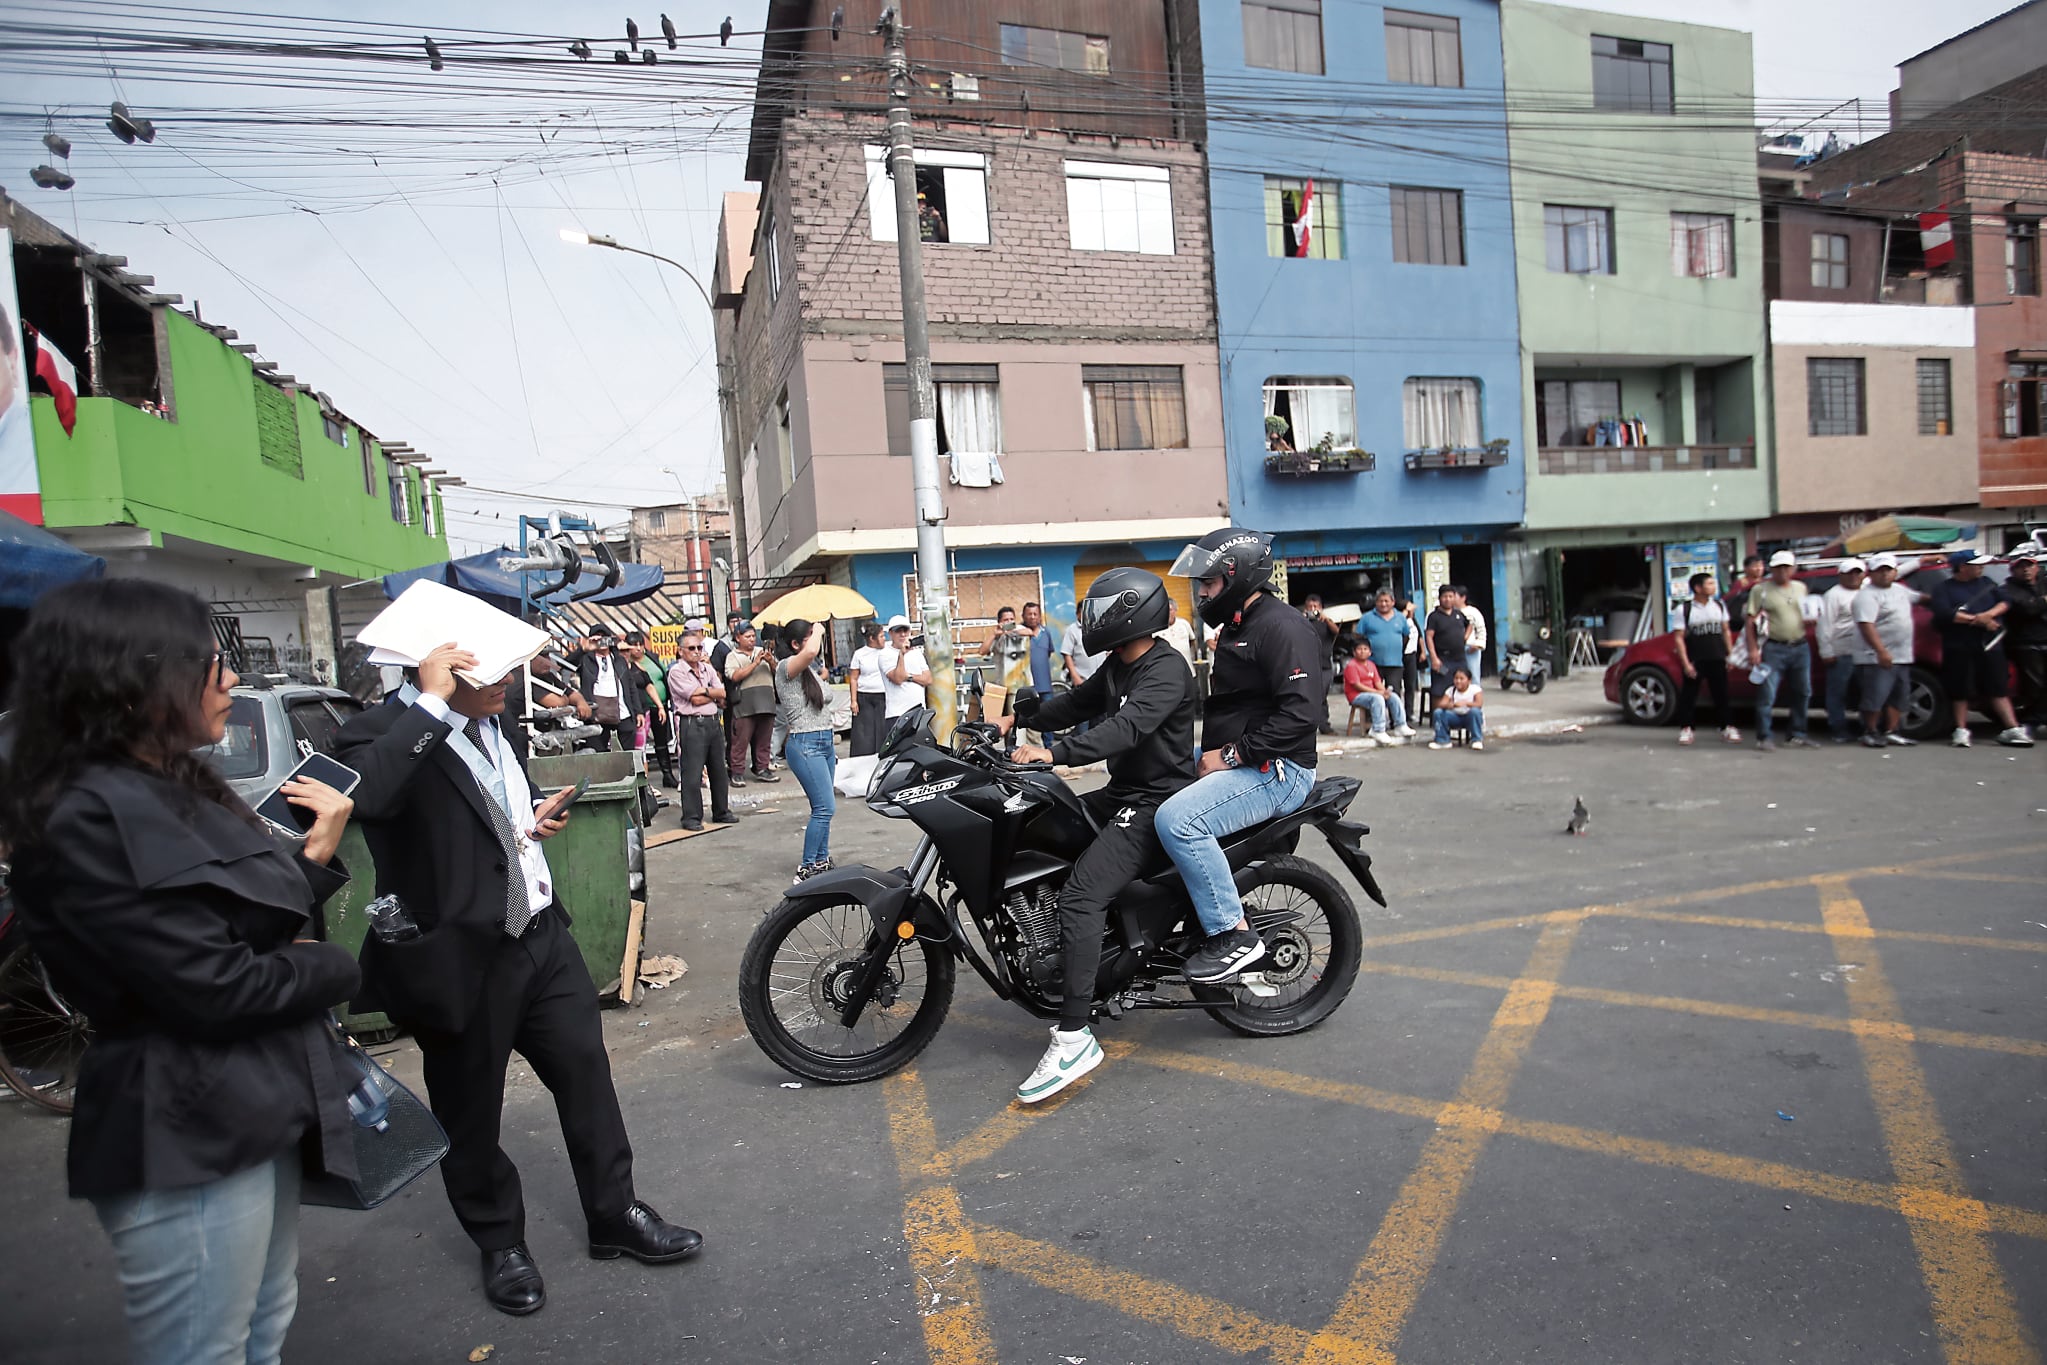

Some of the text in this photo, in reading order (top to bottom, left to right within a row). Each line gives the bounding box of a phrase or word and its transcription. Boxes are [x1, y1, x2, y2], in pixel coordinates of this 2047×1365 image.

[1206, 537, 1259, 567] SERENAZGO
[906, 793, 937, 805] 300
[1004, 805, 1028, 813] HONDA
